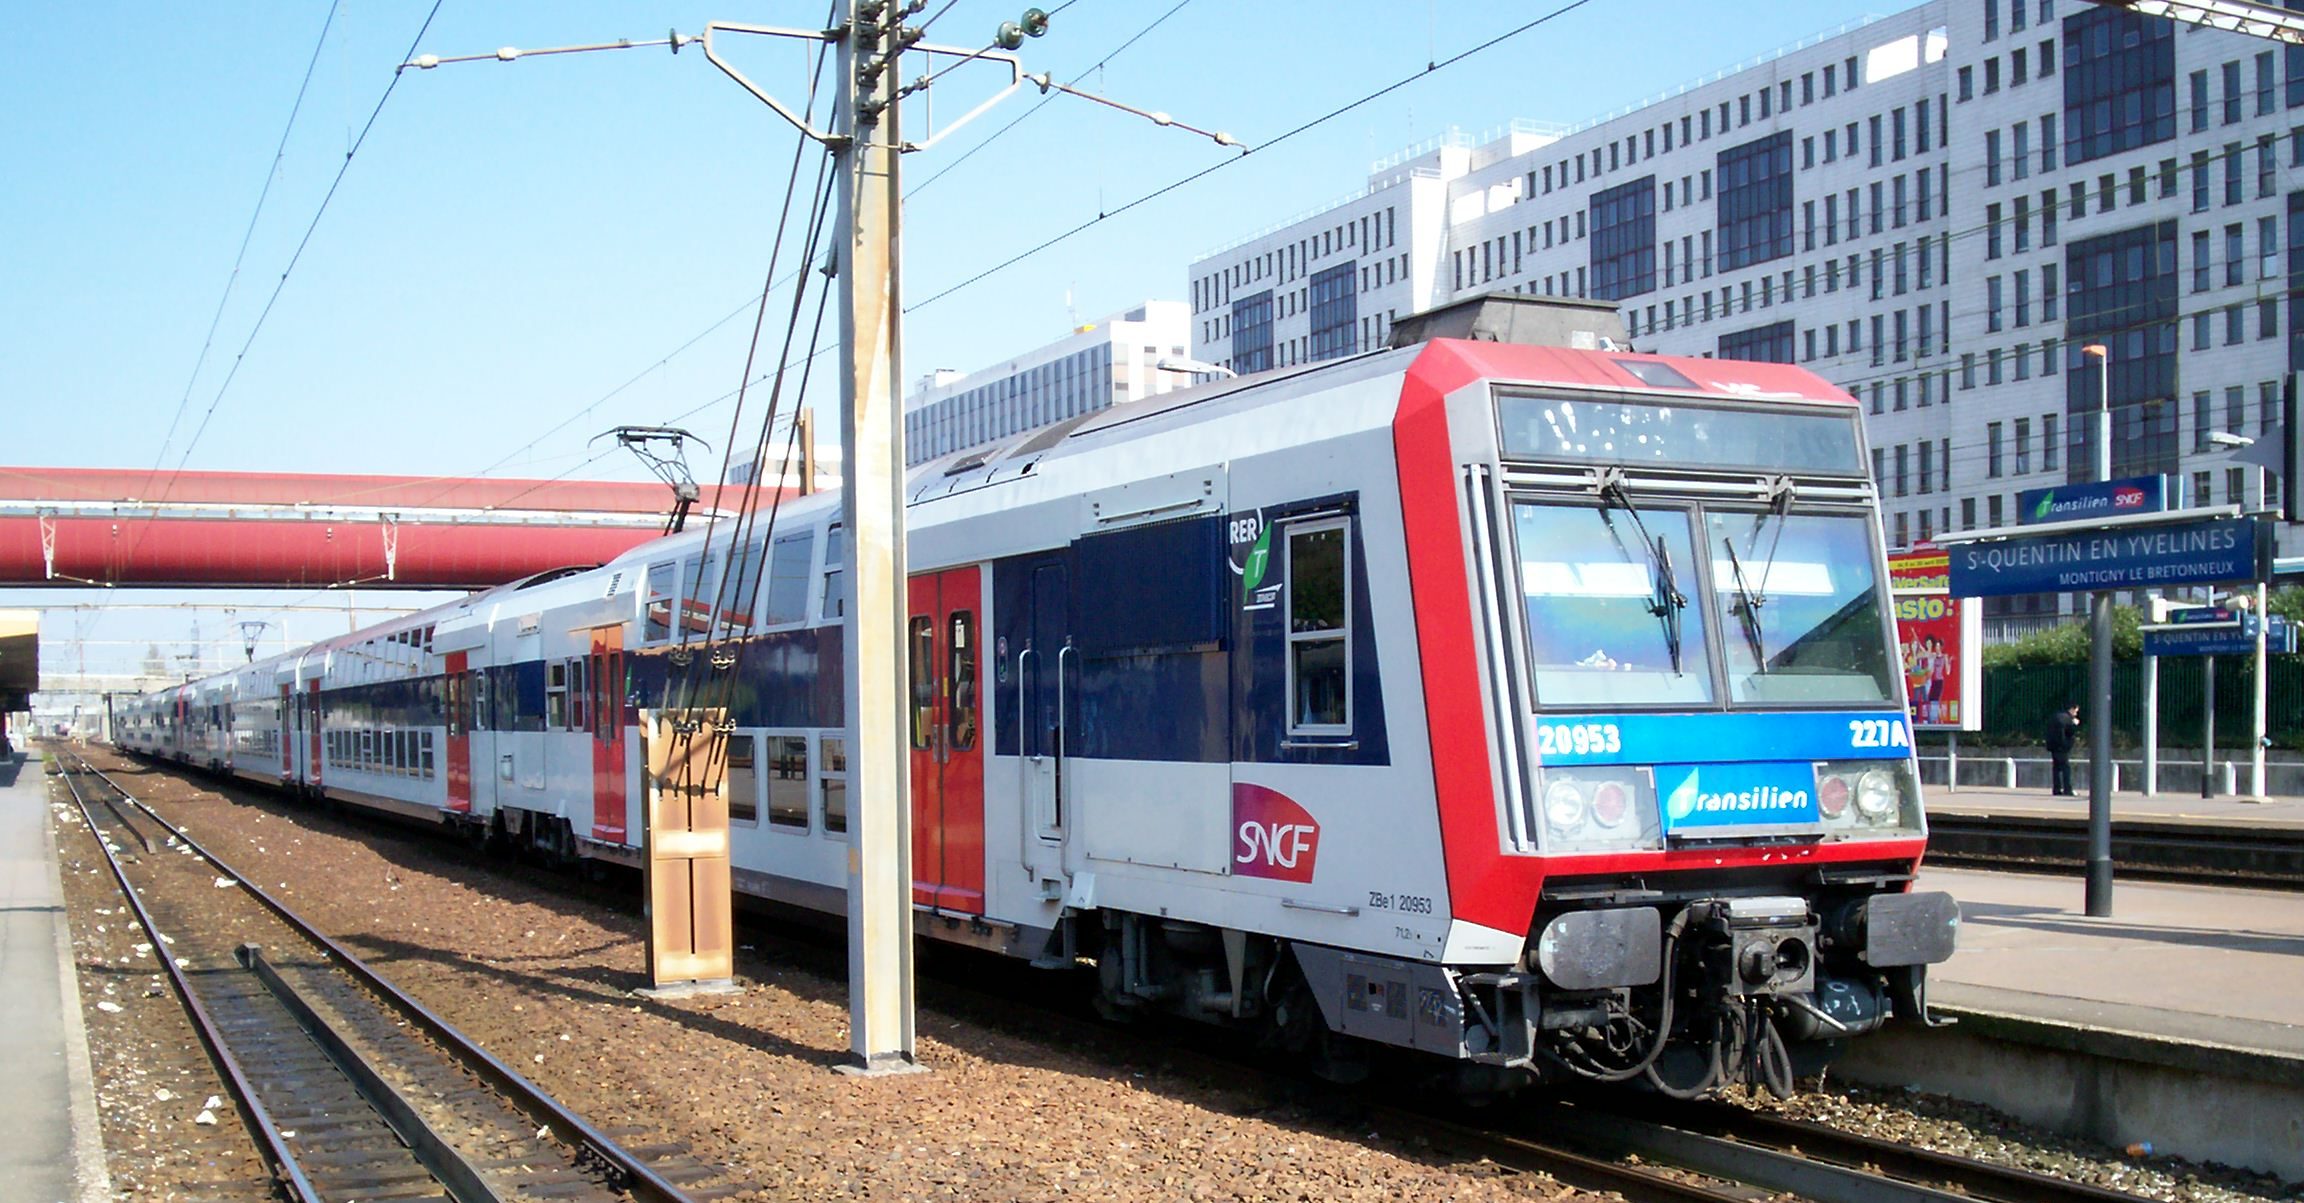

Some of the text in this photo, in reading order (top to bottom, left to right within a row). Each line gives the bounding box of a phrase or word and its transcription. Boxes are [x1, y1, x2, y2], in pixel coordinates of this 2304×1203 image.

[2042, 496, 2108, 513] Transilien
[2114, 491, 2143, 507] SNCF
[1229, 517, 1257, 545] RER
[2090, 538, 2118, 560] EN
[2127, 527, 2236, 556] YVELINES
[2059, 560, 2235, 585] MONTIGNY LE BRETONNEUX
[1538, 723, 1621, 756] 20953
[1848, 719, 1908, 747] 227A
[1676, 785, 1808, 814] Transilien
[1236, 820, 1315, 869] SNCF
[1399, 895, 1432, 914] 20953
